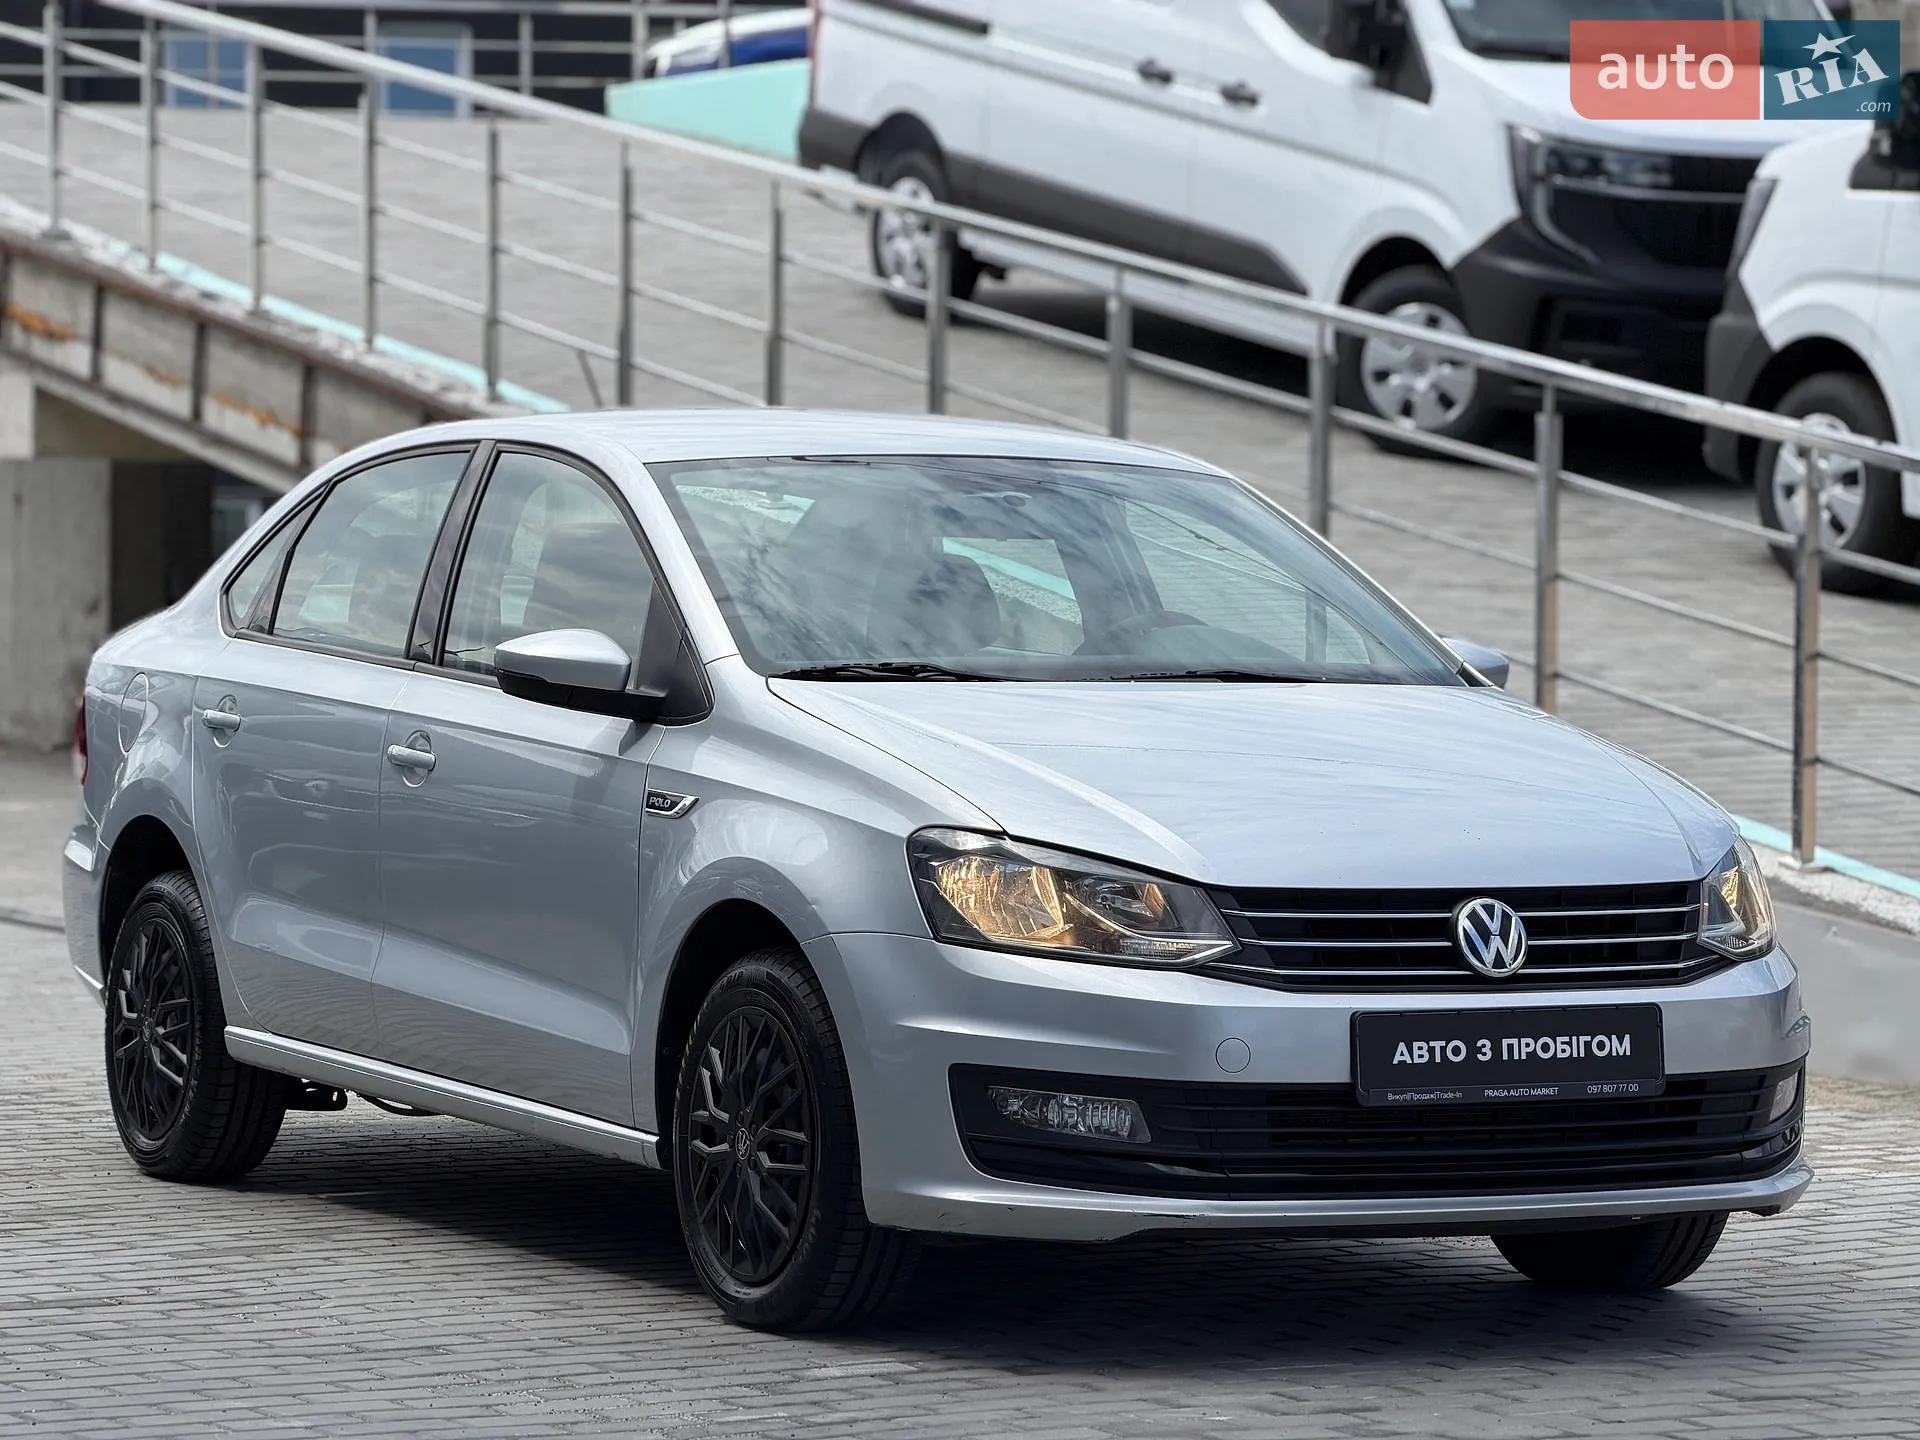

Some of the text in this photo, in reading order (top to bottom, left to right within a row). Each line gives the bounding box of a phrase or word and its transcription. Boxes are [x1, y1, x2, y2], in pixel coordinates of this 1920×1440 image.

[649, 796, 671, 808] POLO
[1392, 1039, 1467, 1065] АВТО
[1501, 1034, 1632, 1061] ПРОБІГОМ
[1484, 1087, 1560, 1097] PRAGA AUTO MARKET
[1587, 1083, 1639, 1094] 097 807 77 00
